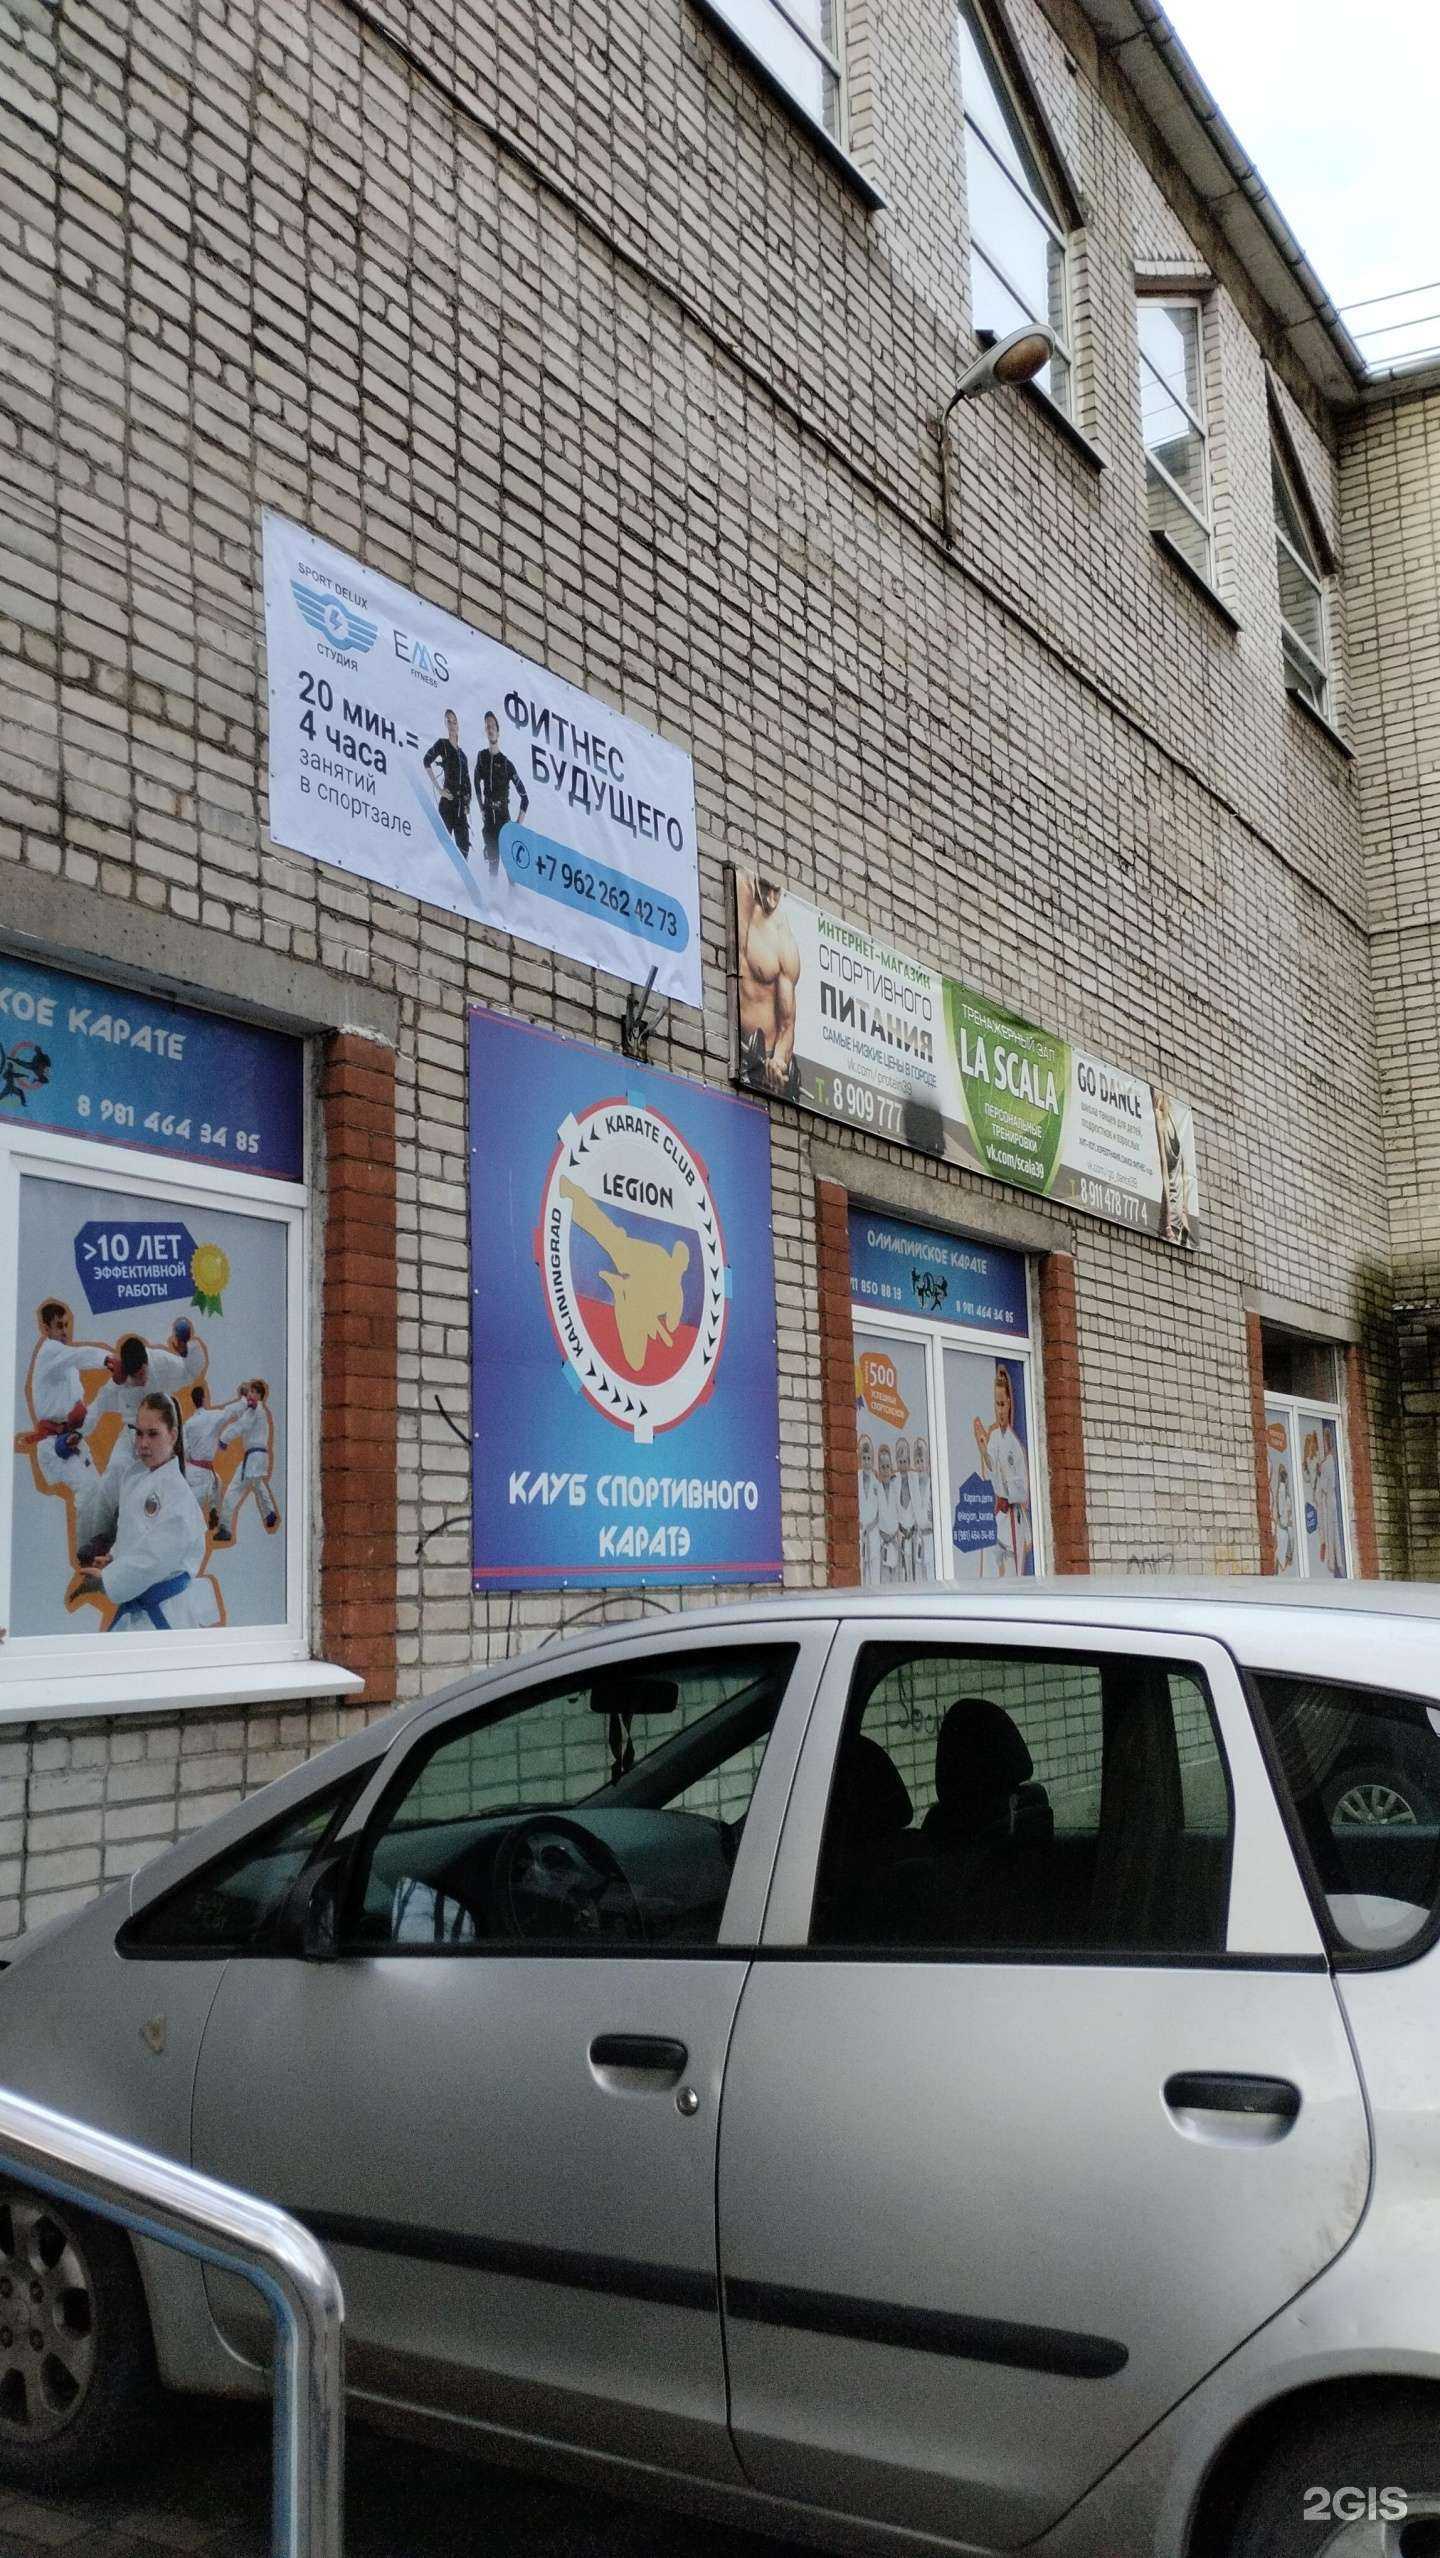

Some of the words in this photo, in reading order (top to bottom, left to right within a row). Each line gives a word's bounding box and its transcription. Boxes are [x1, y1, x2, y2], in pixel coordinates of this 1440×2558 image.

[298, 562, 331, 590] SPORT
[335, 583, 368, 609] DELUX
[317, 643, 359, 672] СТУДИЯ
[411, 668, 438, 688] FITNESS
[299, 670, 333, 712] 20
[299, 709, 317, 741] 4
[326, 725, 388, 775] часа
[503, 690, 625, 783] ФИТНЕС
[299, 749, 376, 796] занятий
[318, 783, 412, 837] спортзале
[531, 744, 685, 852] БУДУЩЕГО
[561, 864, 596, 900] 962
[599, 881, 631, 917] 262
[635, 899, 654, 928] 42
[658, 907, 678, 937] 73
[818, 917, 931, 990] ИНТЕРНЕТ-МАГАЗИН
[819, 944, 932, 1022] СПОРТИВНОГО
[69, 1007, 186, 1061] КАРАТЕ
[820, 981, 934, 1063] ПИТАНИЯ
[822, 1026, 851, 1051] САМЫЕ
[961, 1027, 991, 1084] LA
[994, 1045, 1060, 1116] SCALA
[1077, 1062, 1096, 1097] GO
[1100, 1072, 1142, 1120] DANCE
[833, 1078, 843, 1110] 8
[846, 1083, 874, 1122] 909
[77, 1095, 91, 1117] 8
[100, 1100, 135, 1127] 981
[144, 1112, 191, 1140] 464
[200, 1123, 227, 1148] 34
[236, 1130, 260, 1154] 85
[605, 1114, 660, 1143] KARATE
[663, 1135, 697, 1188] CLUB
[602, 1172, 674, 1210] LEGION
[93, 1261, 187, 1280] ЭФФЕКТИВНОЙ
[135, 1234, 182, 1261] ЛЕТ
[951, 1251, 988, 1275] КАРАТЕ
[117, 1282, 168, 1298] РАБОТЫ
[551, 1207, 584, 1358] KALININGRAD
[870, 1361, 895, 1388] 500
[509, 1471, 588, 1507] КЛУБ
[596, 1475, 759, 1511] СПОРТИВНОГО
[599, 1525, 691, 1558] КАРАТЭ
